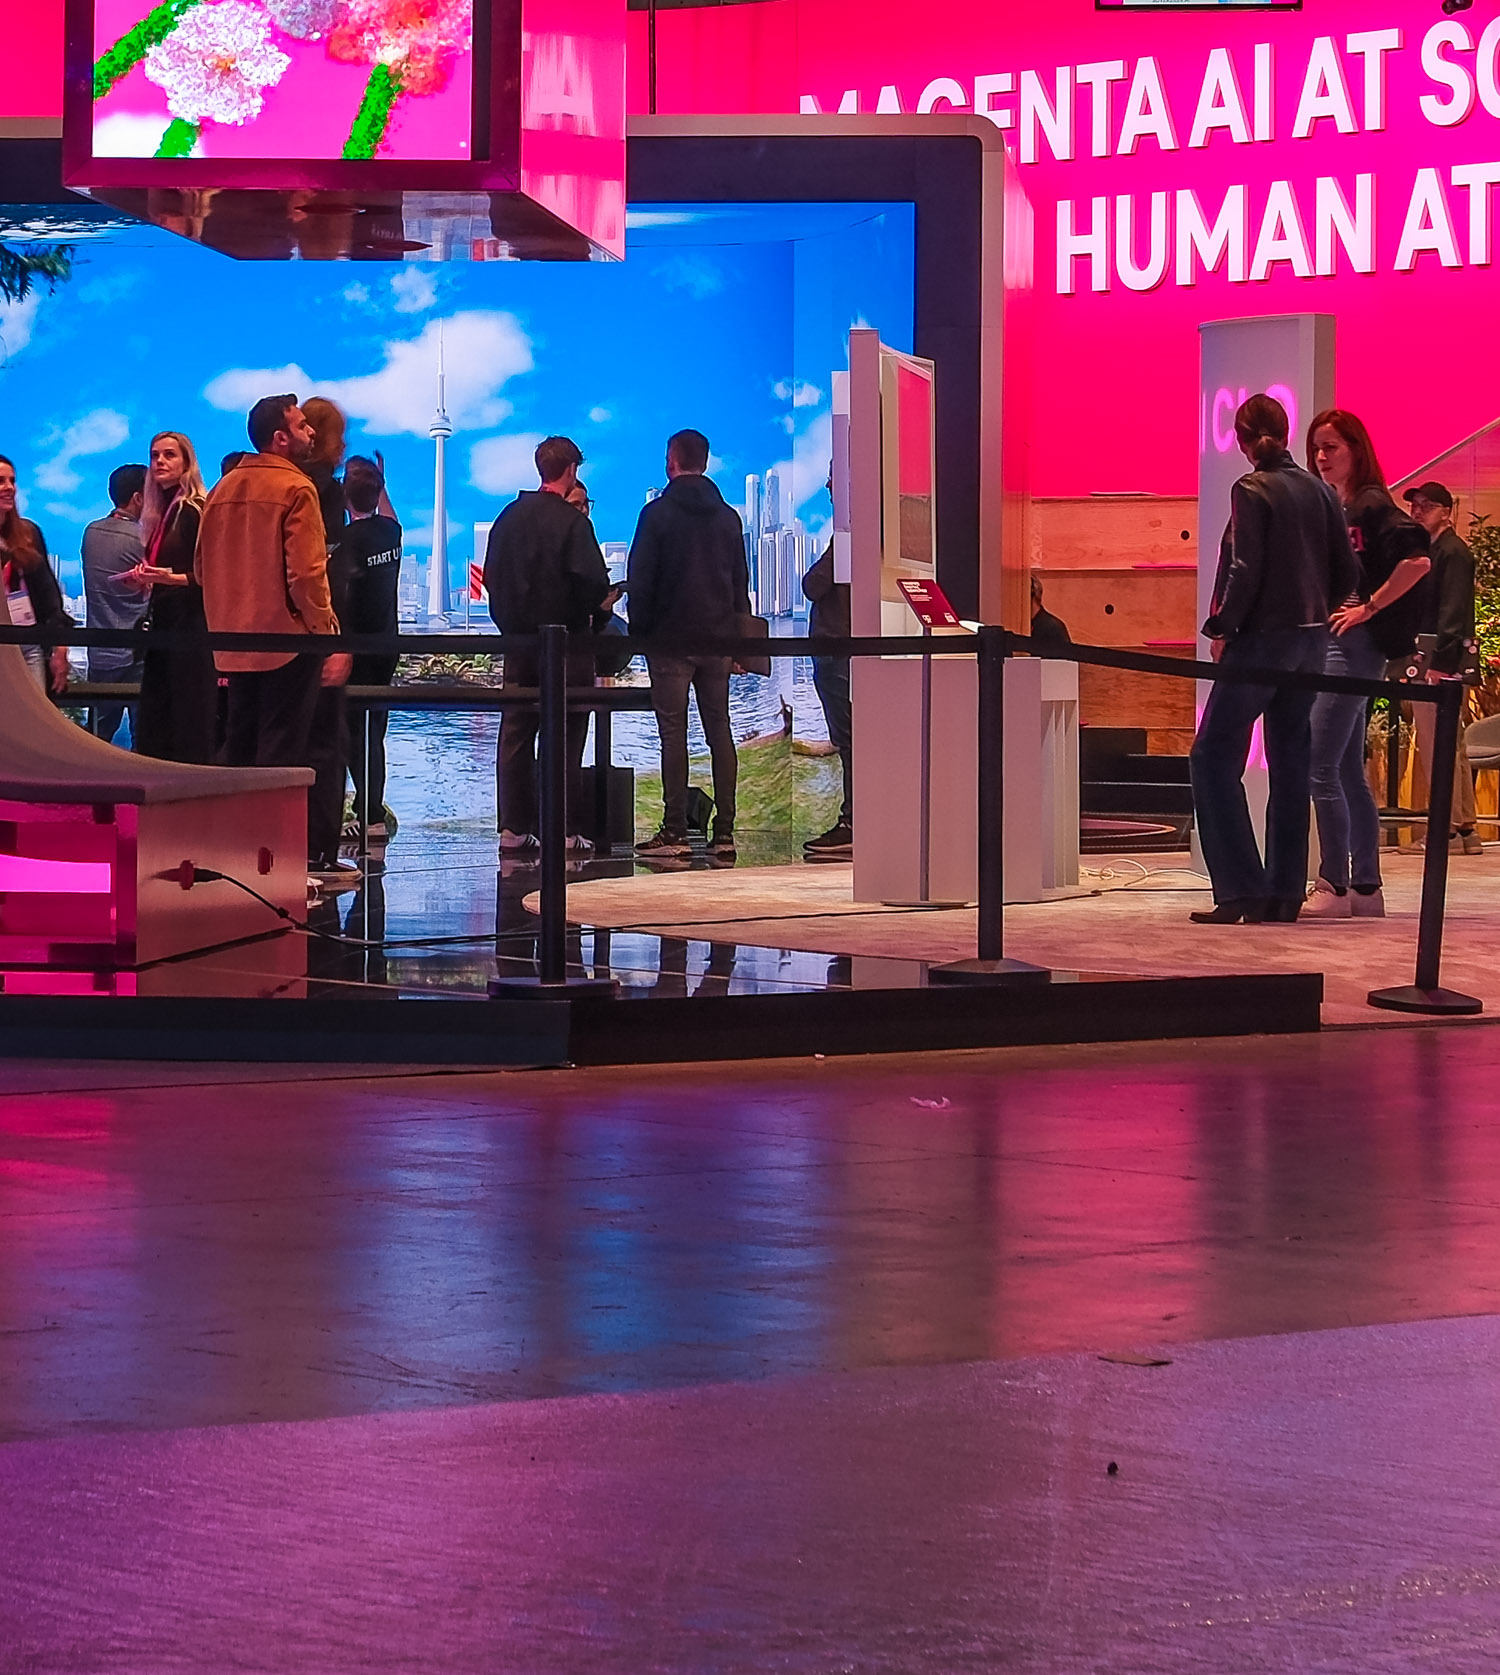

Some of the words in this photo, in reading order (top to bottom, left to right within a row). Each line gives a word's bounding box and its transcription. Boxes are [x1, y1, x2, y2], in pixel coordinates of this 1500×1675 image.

[799, 56, 1178, 164] ENTA
[1187, 42, 1273, 148] AI
[1293, 28, 1400, 138] AT
[1057, 170, 1374, 295] HUMAN
[367, 550, 392, 567] START
